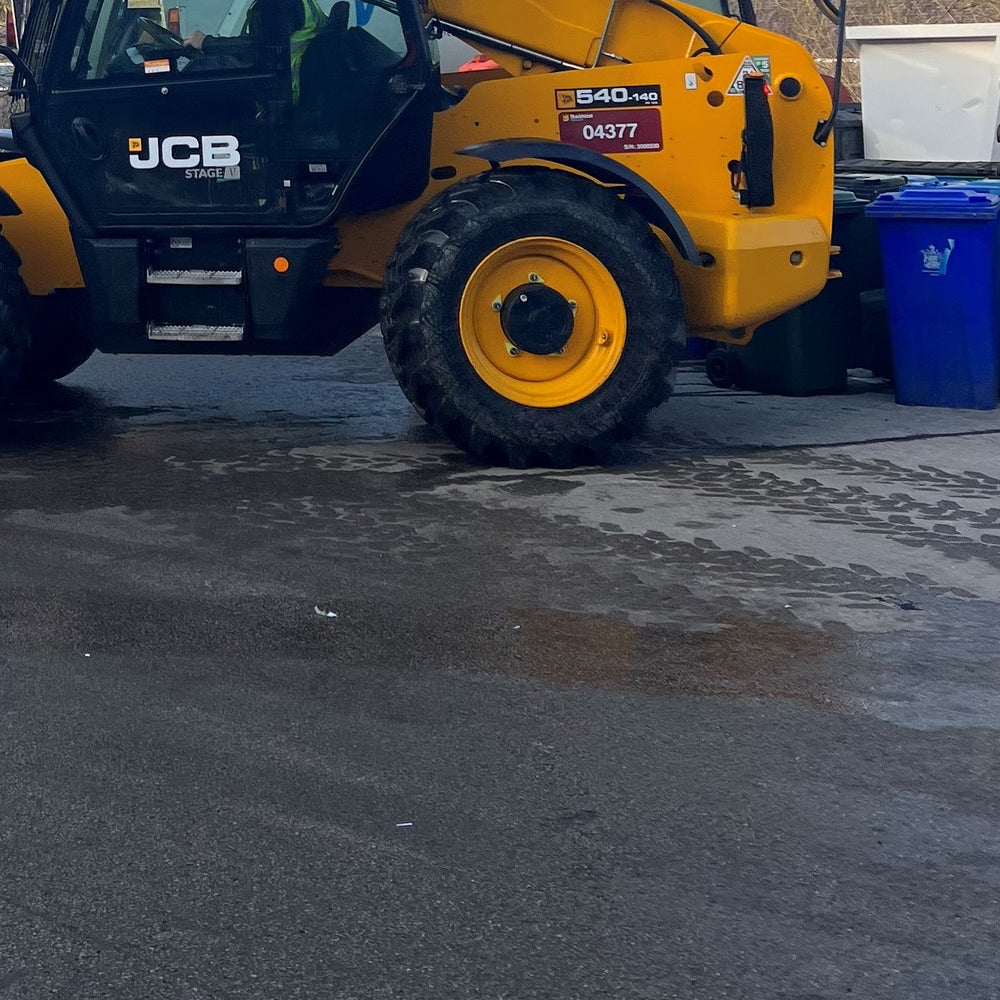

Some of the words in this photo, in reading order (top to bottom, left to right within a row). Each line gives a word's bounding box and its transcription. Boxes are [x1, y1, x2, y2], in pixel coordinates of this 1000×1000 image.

[582, 123, 638, 140] 04377
[129, 135, 241, 169] JCB
[185, 168, 223, 179] STAGE
